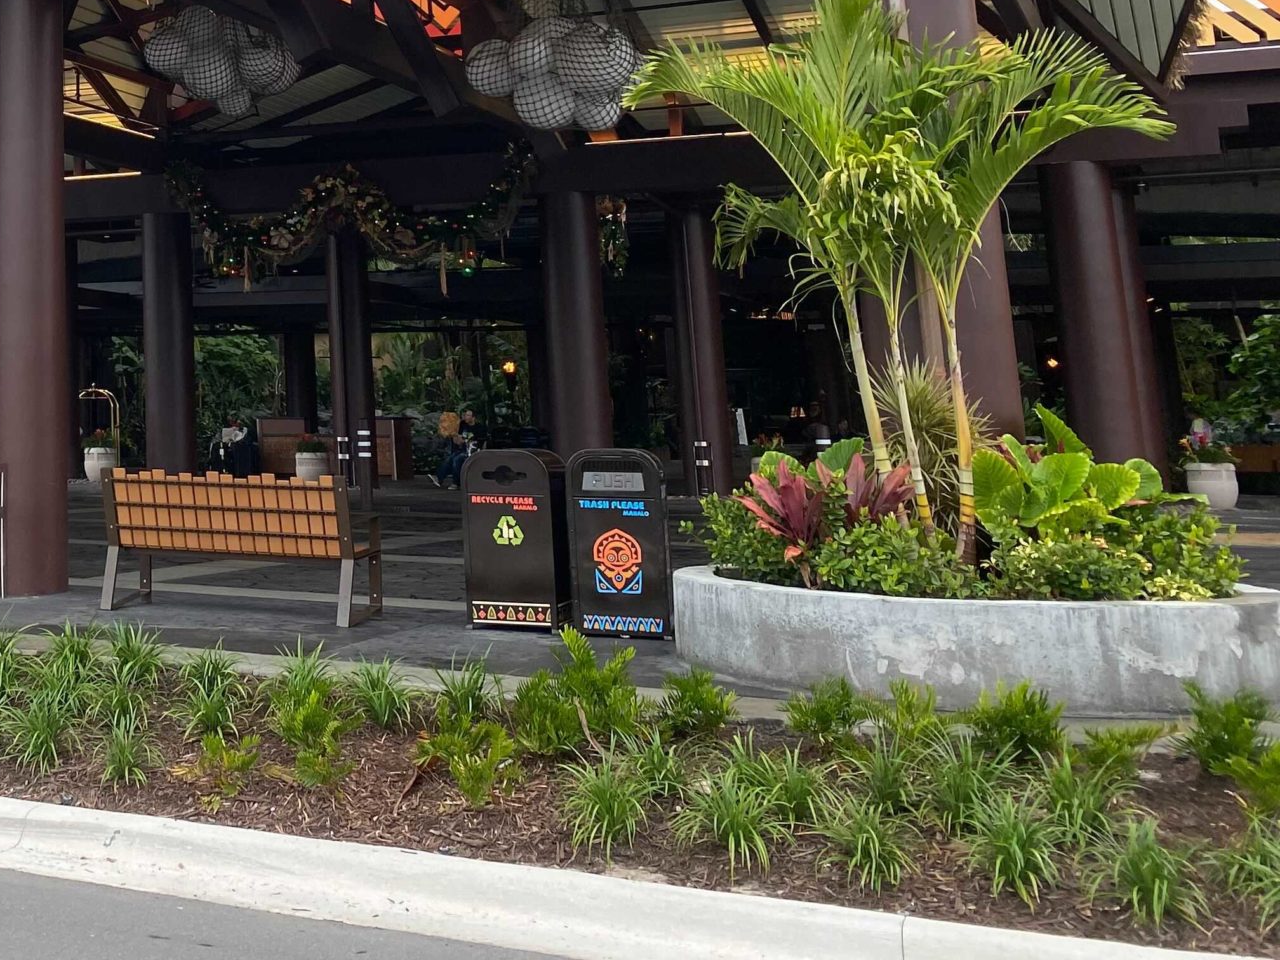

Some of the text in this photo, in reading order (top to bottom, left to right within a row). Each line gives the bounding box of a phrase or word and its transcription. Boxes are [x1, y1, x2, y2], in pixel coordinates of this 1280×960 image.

[592, 473, 635, 489] PUSH
[471, 495, 534, 505] RECYCLE PLEASE
[579, 500, 645, 510] TRASH PLEASE
